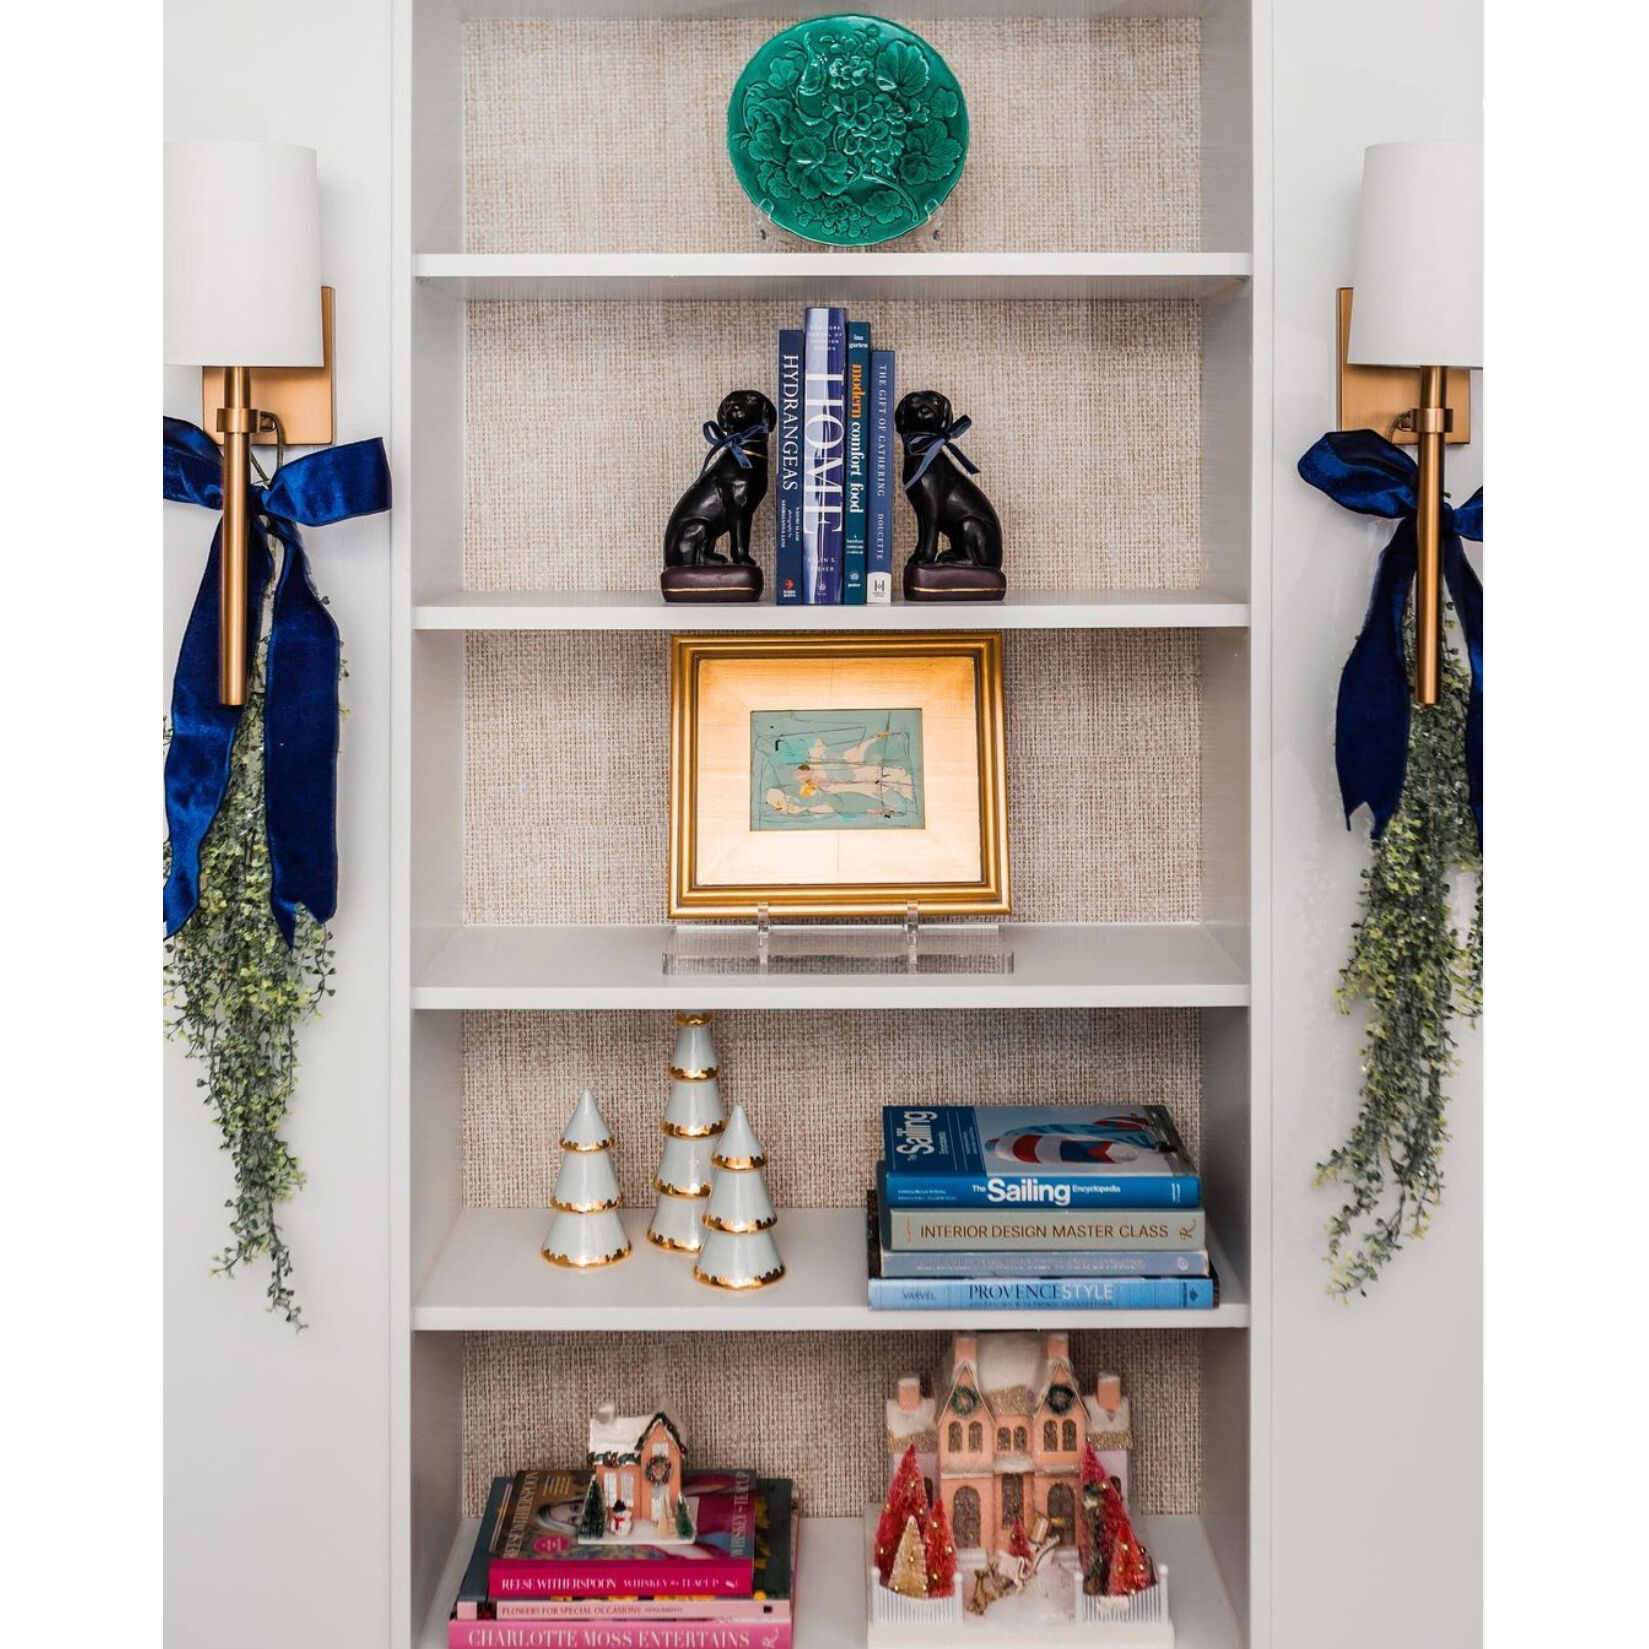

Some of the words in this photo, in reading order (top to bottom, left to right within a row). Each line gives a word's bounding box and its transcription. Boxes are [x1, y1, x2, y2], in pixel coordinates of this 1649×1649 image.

[879, 364, 887, 386] THE
[851, 364, 866, 419] modern
[878, 390, 887, 415] GIFT
[782, 355, 799, 491] HYDRANGEAS
[878, 418, 887, 431] OF
[803, 373, 845, 534] HOME
[850, 422, 866, 476] comfort
[877, 435, 887, 497] GATHERING
[849, 483, 864, 513] food
[876, 513, 885, 560] DOUCETTE
[896, 1110, 938, 1155] Sailing
[972, 1184, 987, 1193] The
[987, 1177, 1070, 1206] Sailing
[1072, 1184, 1121, 1194] Encyclopedia
[920, 1225, 987, 1238] INTERIOR
[991, 1225, 1047, 1238] DESIGN
[1052, 1225, 1114, 1238] MASTER
[1119, 1225, 1169, 1238] CLASS
[969, 1284, 1061, 1300] PROVENCE
[1062, 1284, 1114, 1300] STYLE
[502, 1579, 534, 1590] REESE
[537, 1578, 617, 1590] WITHERSPOON
[623, 1579, 668, 1588] WHISKEY
[502, 1607, 540, 1615] FLOWERS
[542, 1607, 559, 1615] FOR
[560, 1607, 592, 1615] SPECIAL
[468, 1629, 578, 1648] CHARLOTTE
[583, 1629, 633, 1648] MOSS
[639, 1629, 750, 1648] ENTERTAINS
